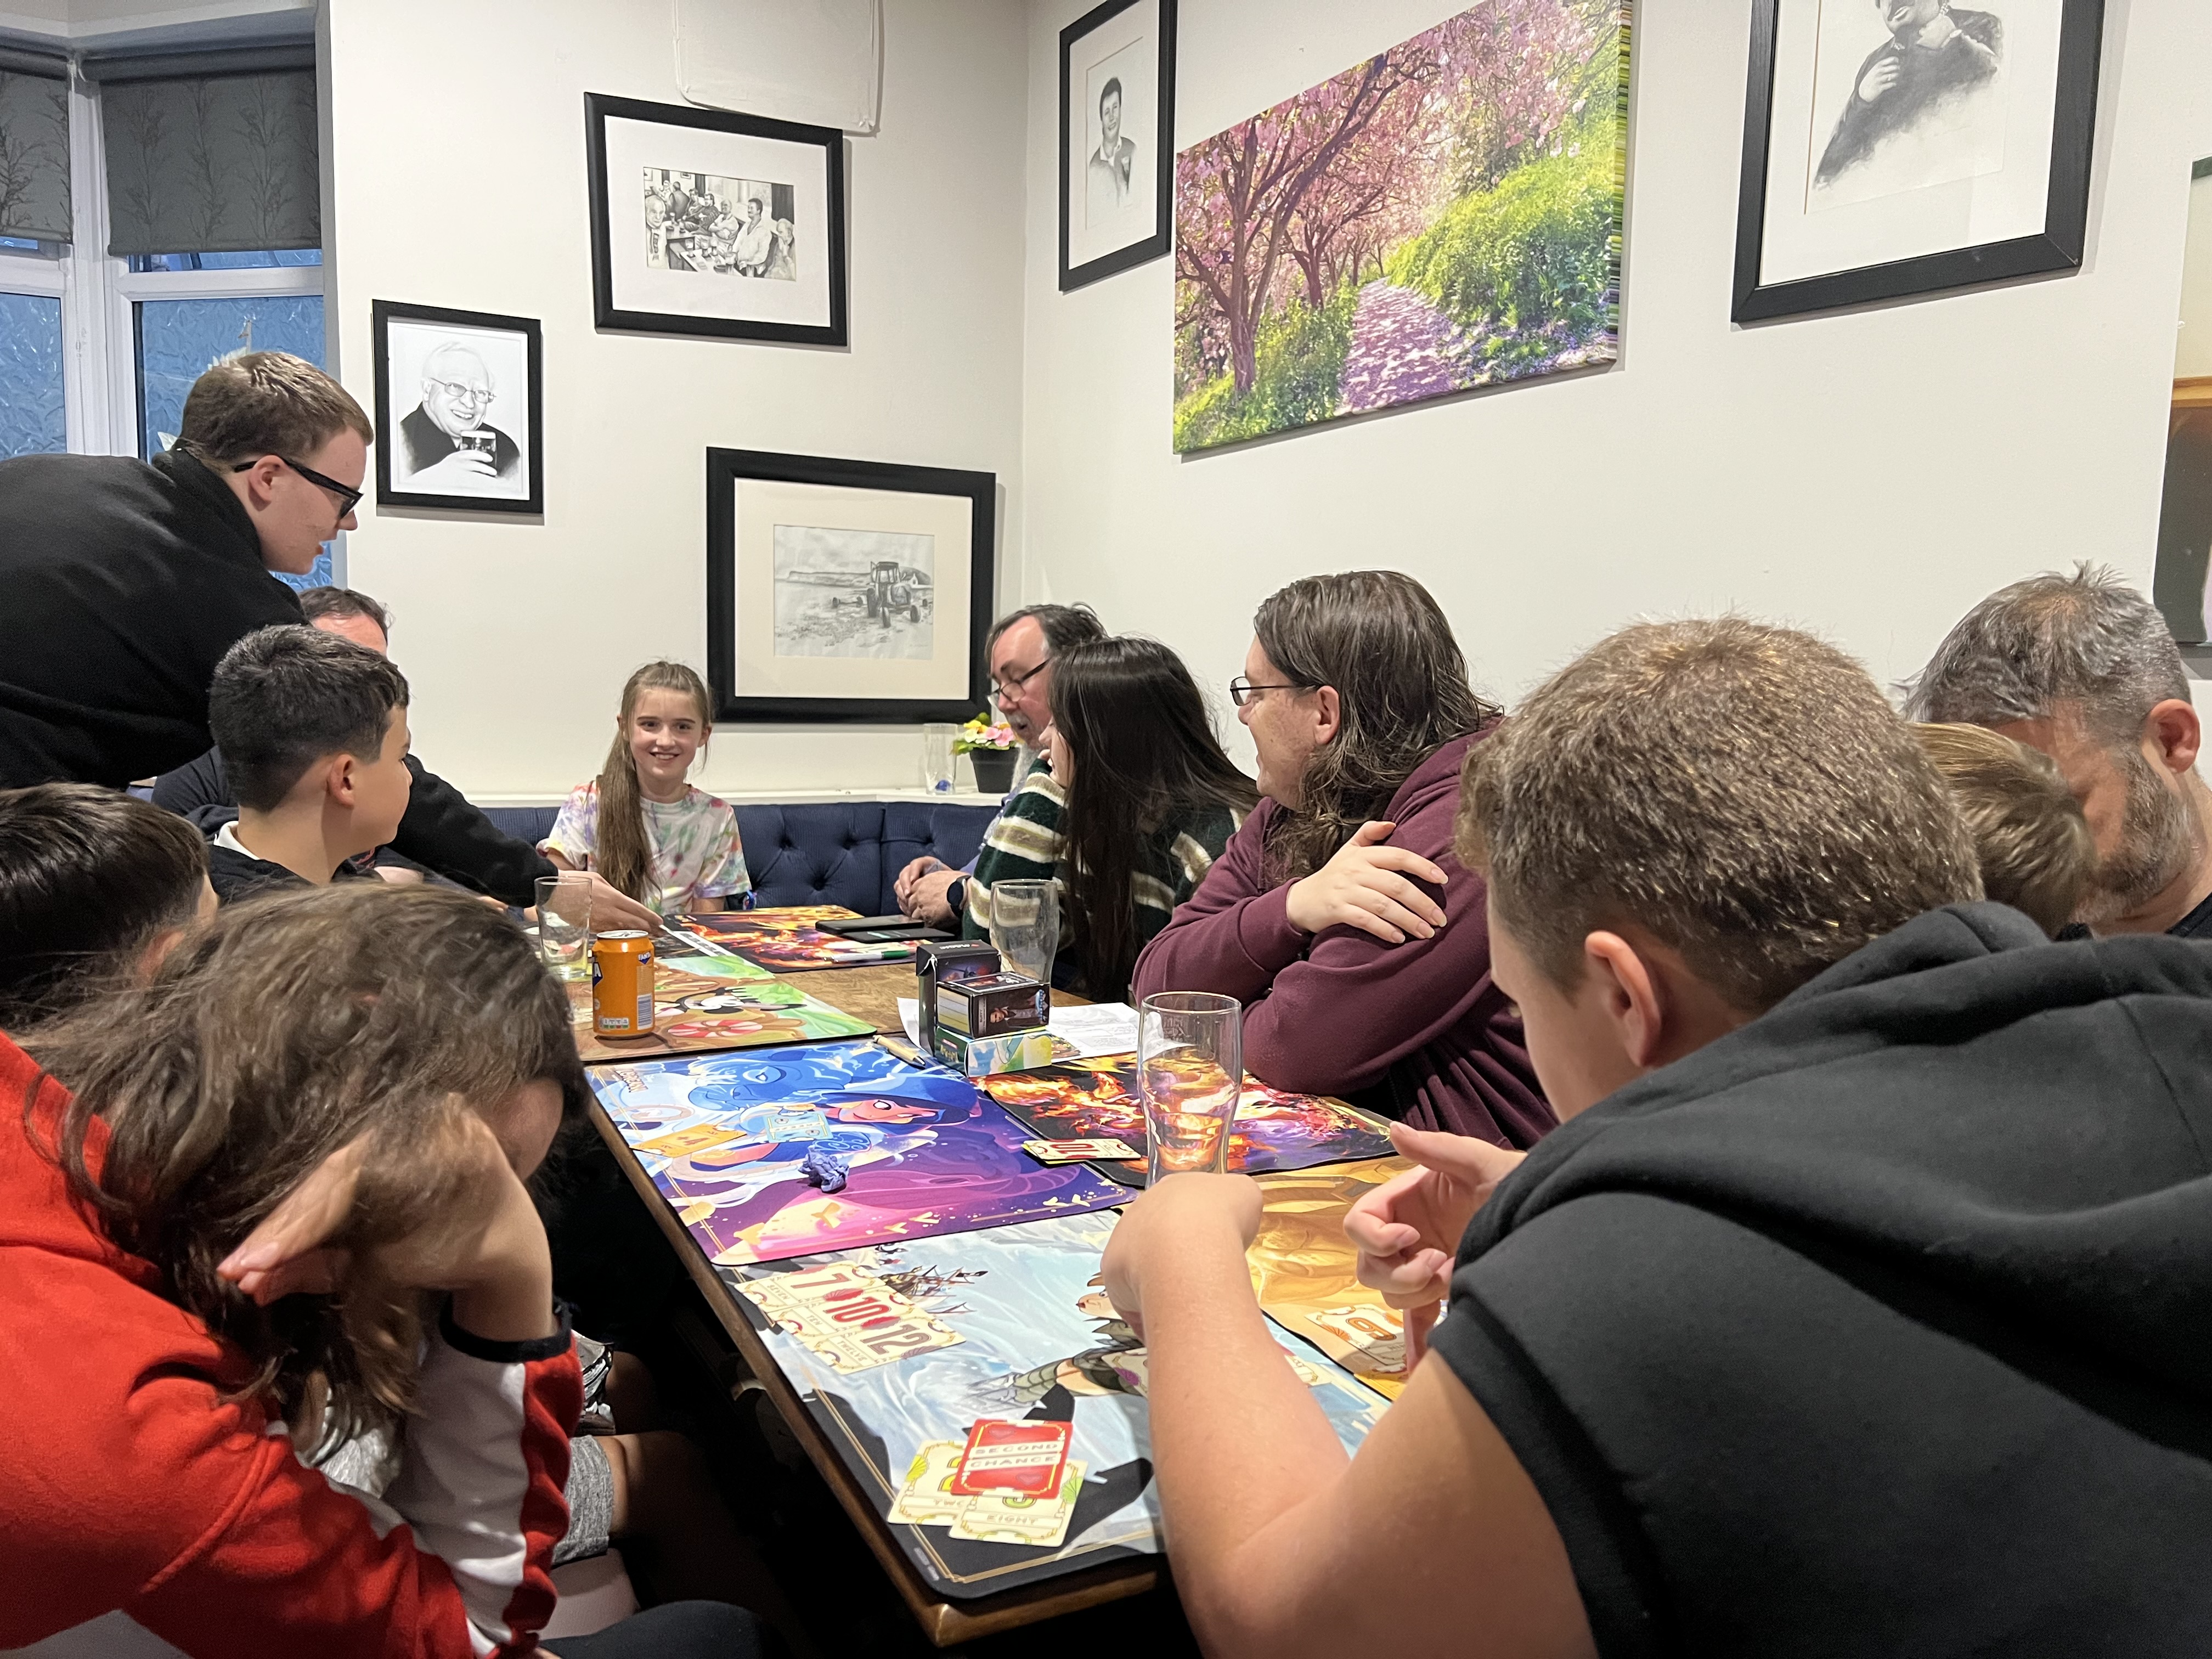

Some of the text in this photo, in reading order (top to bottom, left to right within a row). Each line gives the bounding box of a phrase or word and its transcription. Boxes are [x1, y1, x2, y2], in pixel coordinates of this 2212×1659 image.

[1049, 1143, 1100, 1154] 10
[790, 1273, 851, 1289] 7
[823, 1296, 892, 1323] 10
[806, 1315, 822, 1325] TEN
[1346, 1317, 1397, 1341] 9
[860, 1324, 932, 1355] 12
[837, 1340, 867, 1361] TWELVE
[975, 1443, 1058, 1454] SECOND
[970, 1455, 1056, 1468] CHANCE
[987, 1514, 1039, 1525] EIGHT
